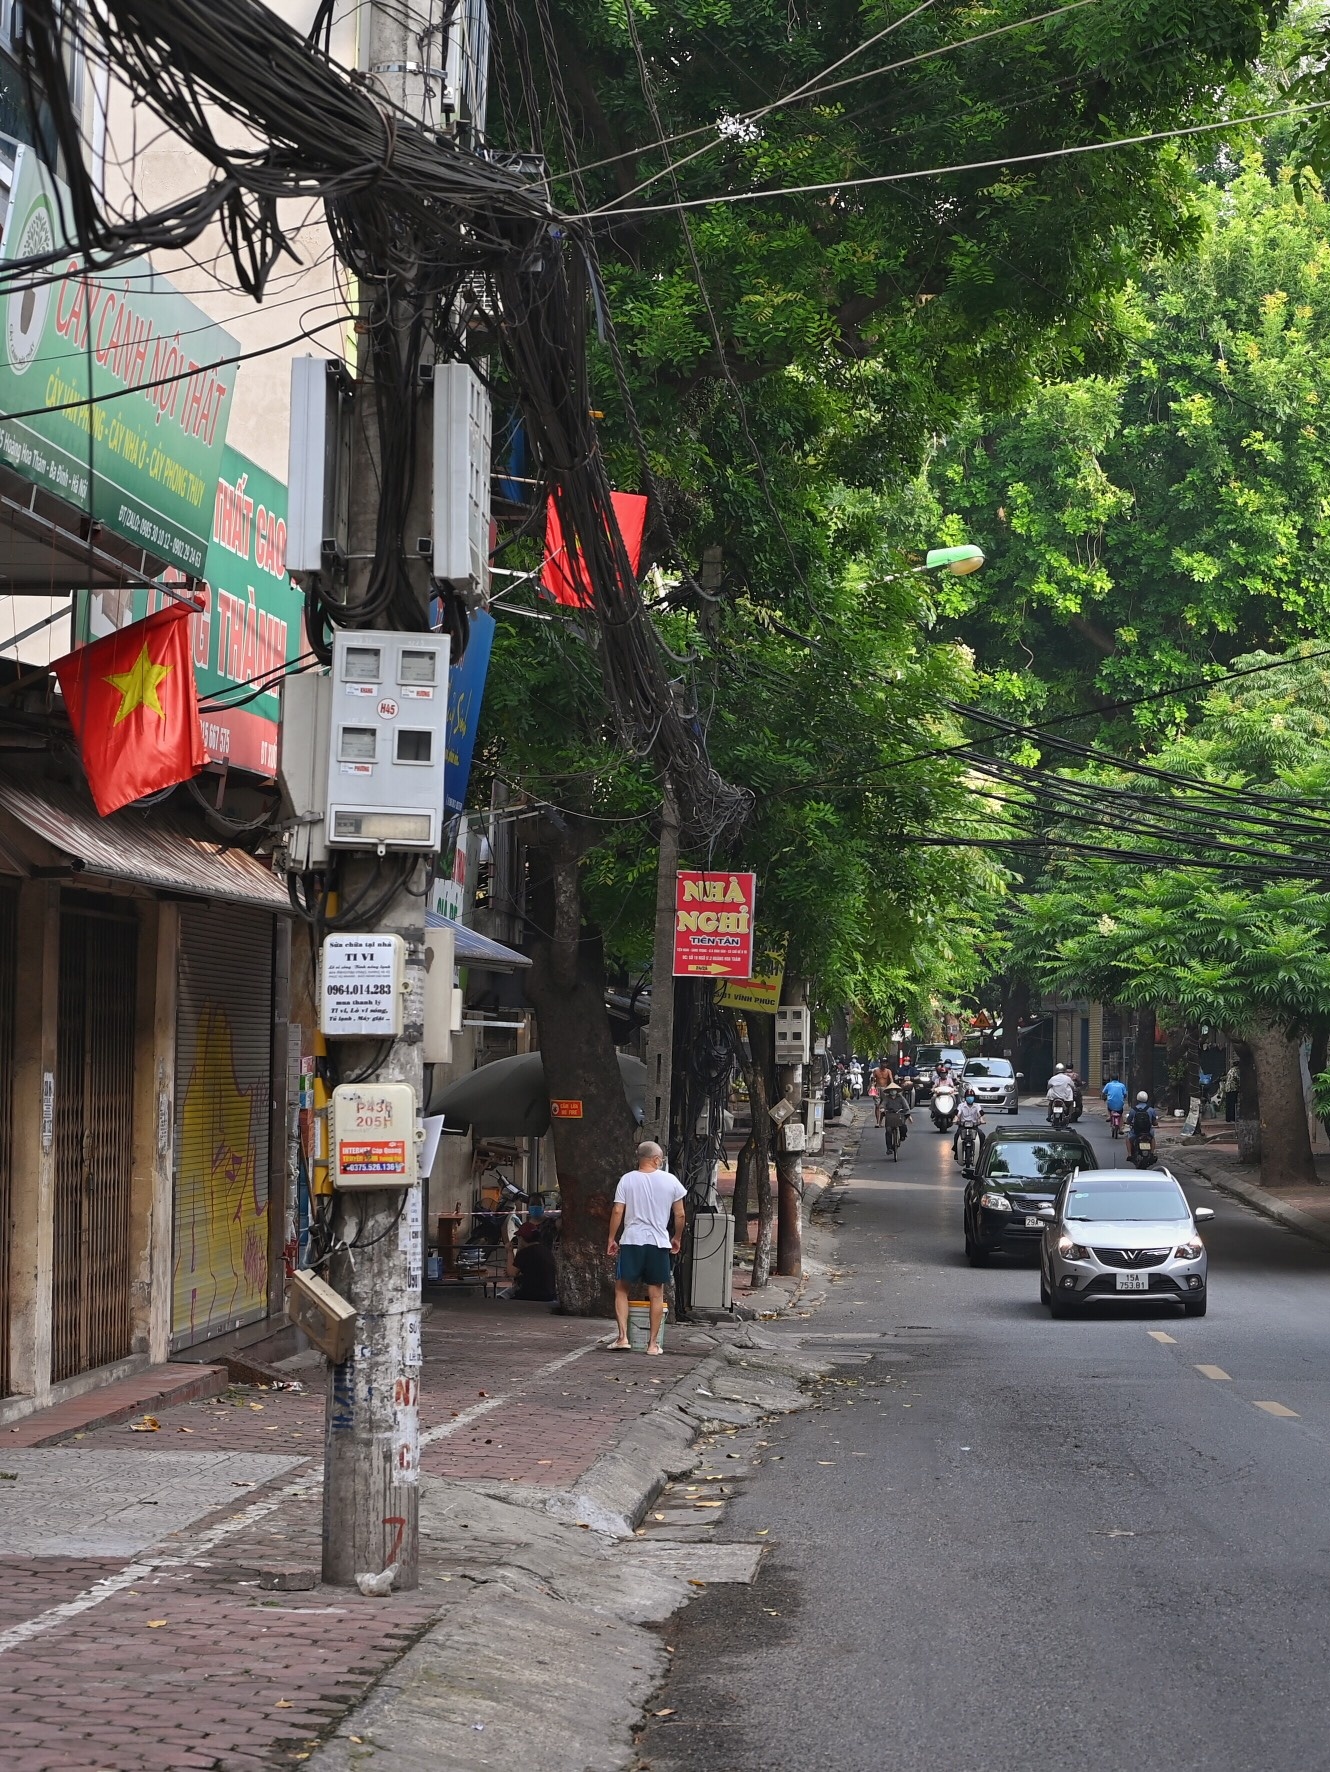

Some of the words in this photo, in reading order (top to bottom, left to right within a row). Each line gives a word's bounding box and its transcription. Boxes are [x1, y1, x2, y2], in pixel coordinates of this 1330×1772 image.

[95, 278, 152, 391] CẢNH
[145, 330, 185, 425] NỘI
[178, 356, 227, 447] THẤT
[4, 431, 21, 464] Hoàng
[20, 443, 33, 466] Hoa
[32, 449, 47, 475] Thám
[49, 460, 58, 480] Ba
[56, 464, 69, 488] Đình
[70, 473, 80, 494] Hà
[78, 478, 88, 503] Nội
[108, 411, 126, 455] CÂY
[122, 423, 140, 467] NHÀ
[149, 441, 166, 483] CÂY
[163, 457, 188, 498] PHONG
[213, 472, 254, 561] THẤT
[254, 503, 287, 581] CAO
[217, 585, 288, 699] THÀNH
[380, 704, 395, 715] H45
[683, 876, 746, 904] NHÀ
[677, 905, 749, 934] NGHỈ
[717, 937, 740, 946] TÂN
[345, 953, 357, 961] TI
[361, 953, 374, 961] VI
[327, 984, 391, 996] 0964.014.283
[356, 1116, 393, 1128] 205H
